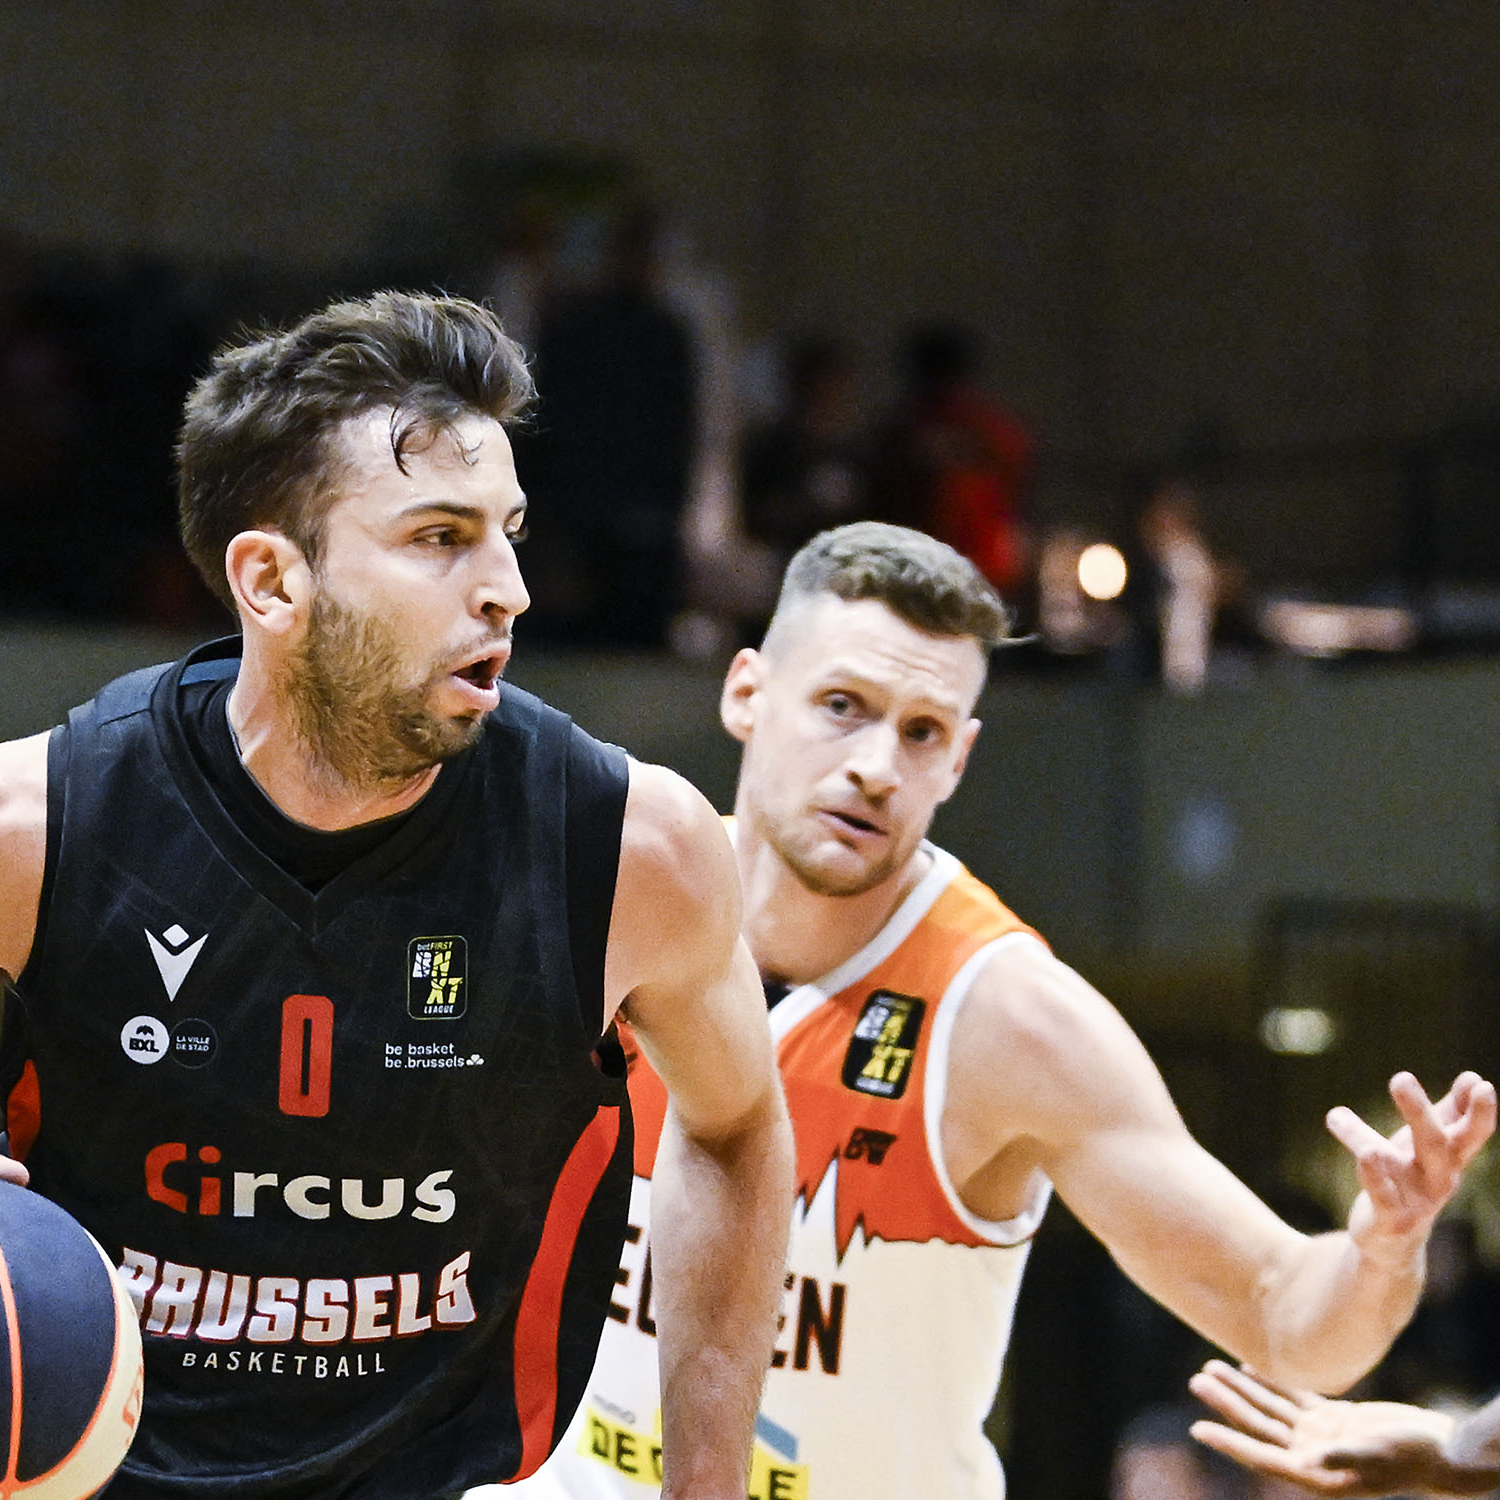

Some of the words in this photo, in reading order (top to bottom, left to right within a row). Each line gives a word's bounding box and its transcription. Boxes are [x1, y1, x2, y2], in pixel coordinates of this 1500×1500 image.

[423, 1004, 455, 1015] LEAGUE
[128, 1037, 160, 1053] BXL
[187, 1043, 210, 1053] STAD
[278, 994, 334, 1117] 0
[385, 1042, 403, 1056] be
[407, 1042, 454, 1056] basket
[144, 1141, 457, 1224] Circus
[114, 1247, 479, 1345] BRUSSELS
[181, 1350, 387, 1379] BASKETBALL
